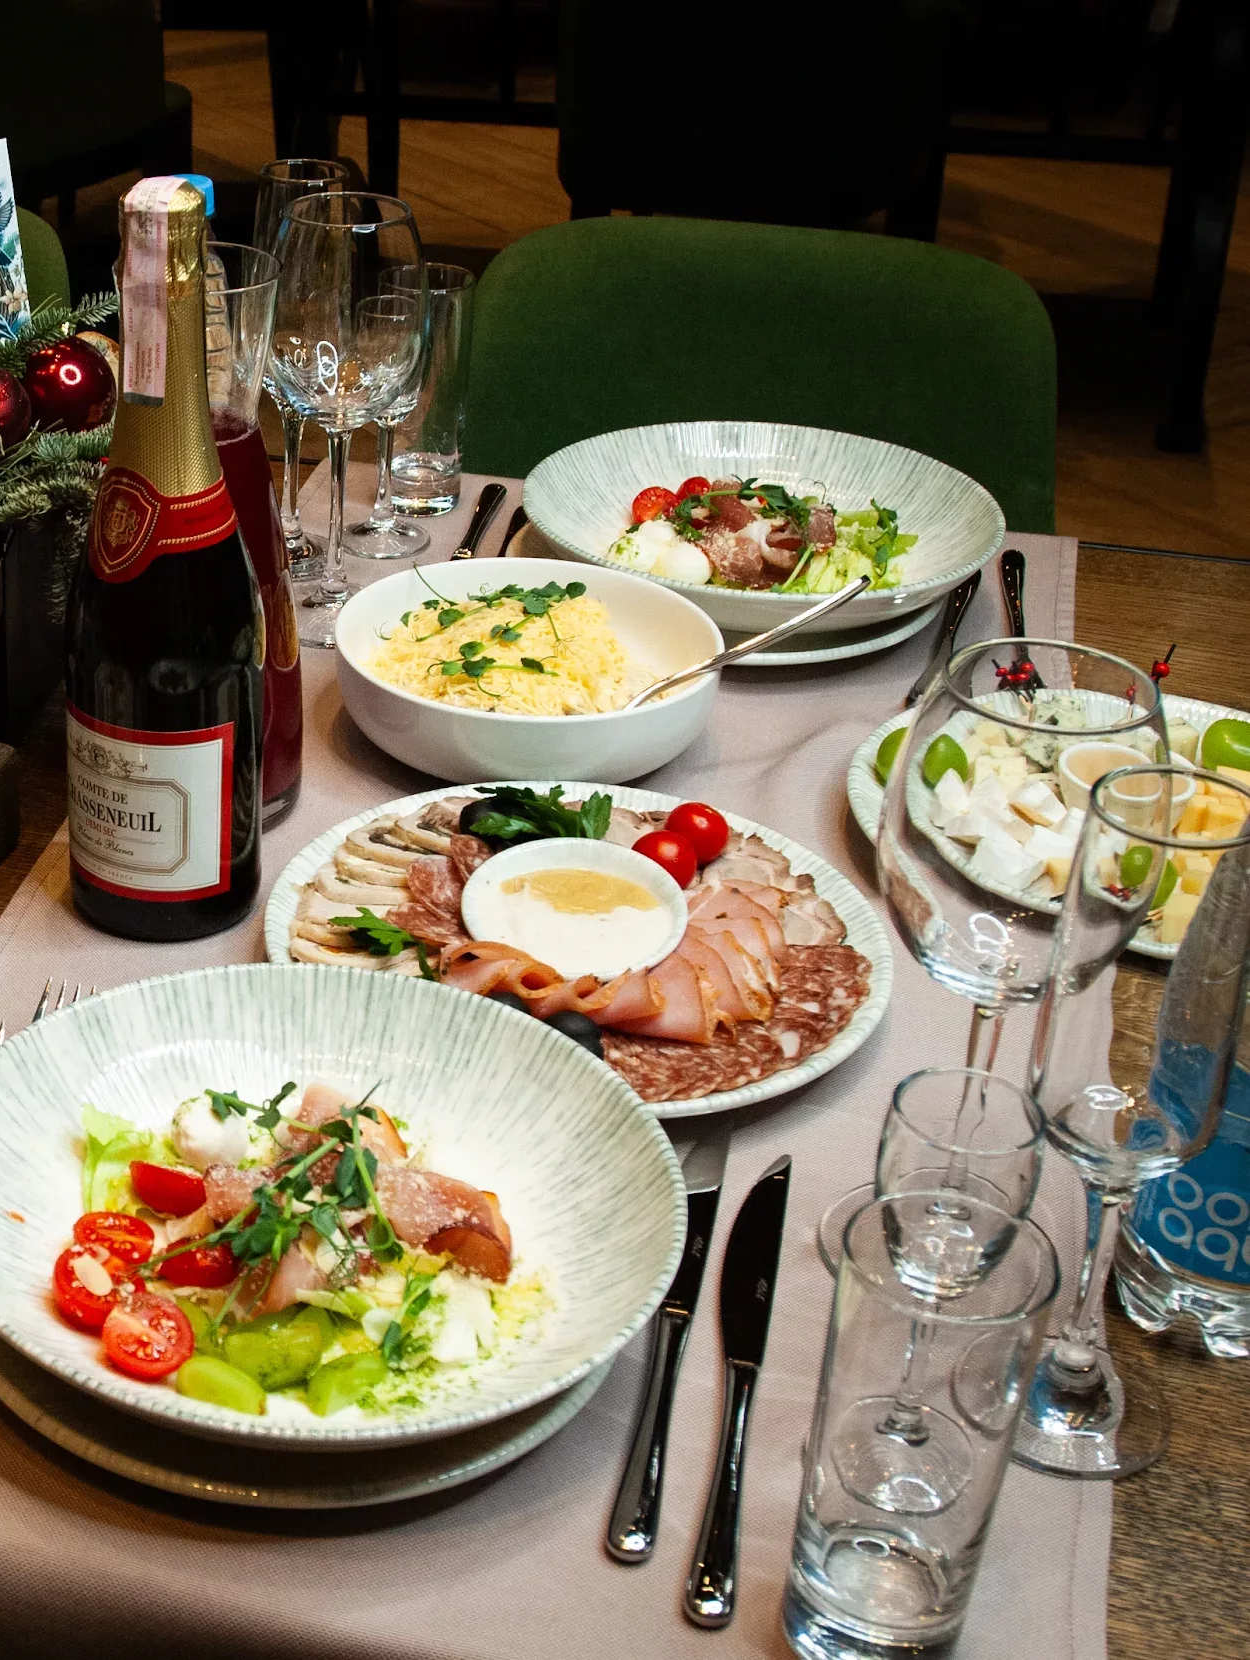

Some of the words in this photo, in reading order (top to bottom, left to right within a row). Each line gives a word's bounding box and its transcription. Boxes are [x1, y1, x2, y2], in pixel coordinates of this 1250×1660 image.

[77, 774, 110, 801] COMTE
[112, 790, 129, 805] DE
[70, 783, 162, 833] HASSENEUIL
[85, 817, 102, 833] DEMI
[103, 826, 117, 838] SEC
